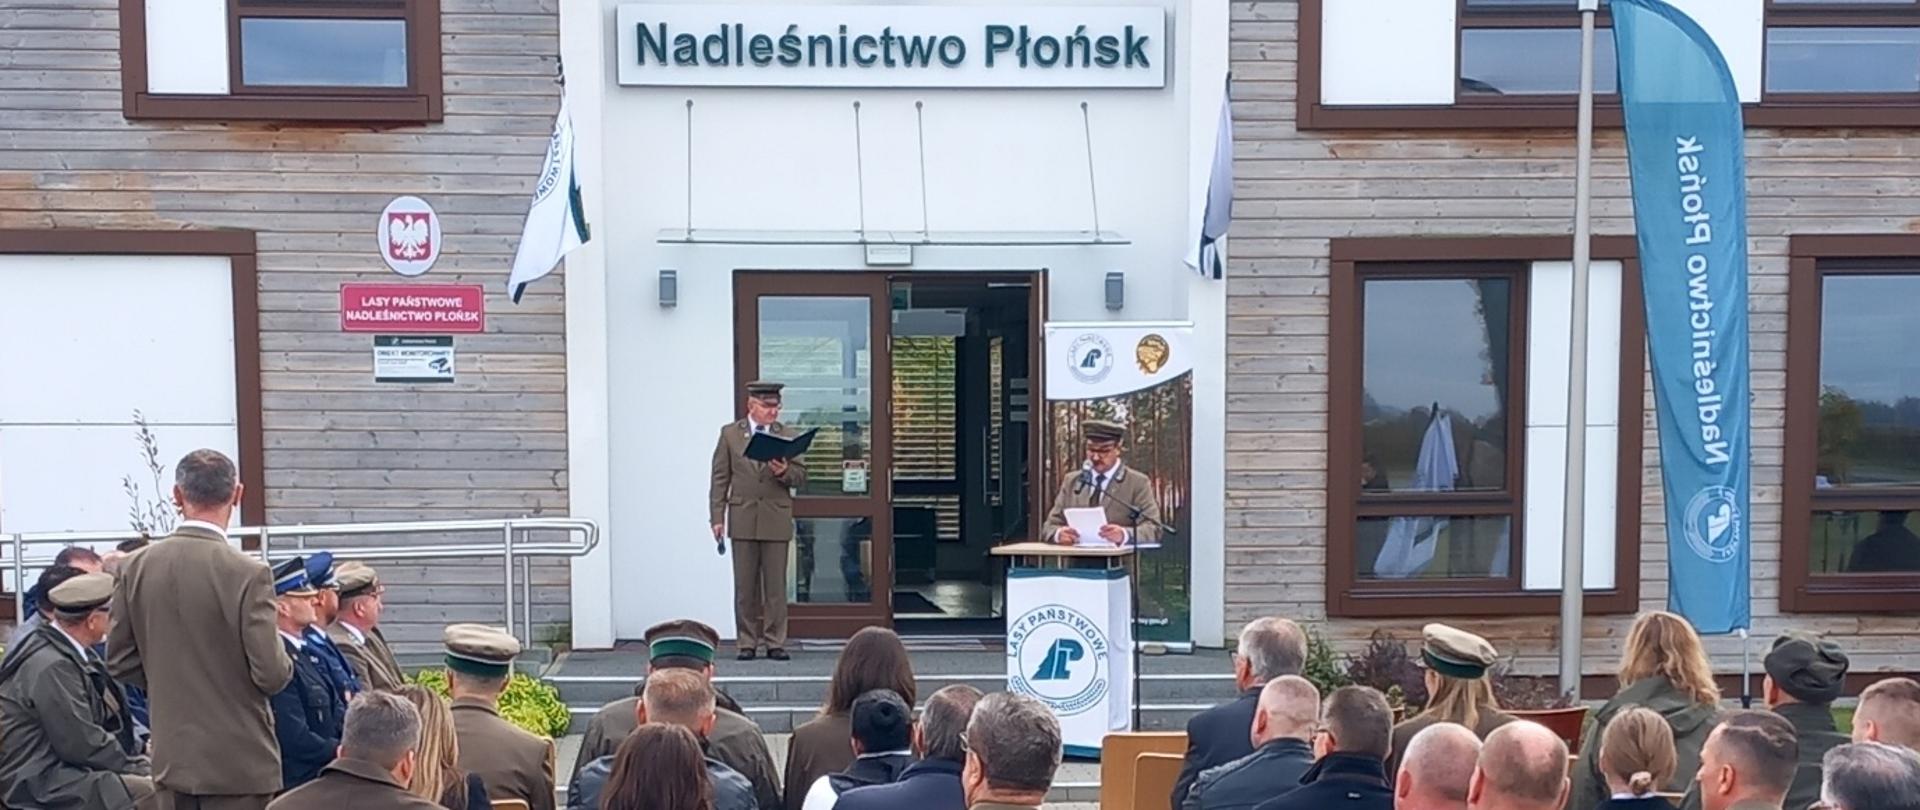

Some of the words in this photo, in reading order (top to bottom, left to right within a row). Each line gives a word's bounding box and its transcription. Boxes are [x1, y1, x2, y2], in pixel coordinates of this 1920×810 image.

[636, 22, 966, 68] Nadleśnictwo
[984, 24, 1150, 68] Płońsk
[361, 297, 390, 307] LASY
[392, 295, 463, 308] PAŃSTWOWE
[346, 309, 432, 321] NADLEŚNICTWO
[1007, 622, 1028, 658] LASY
